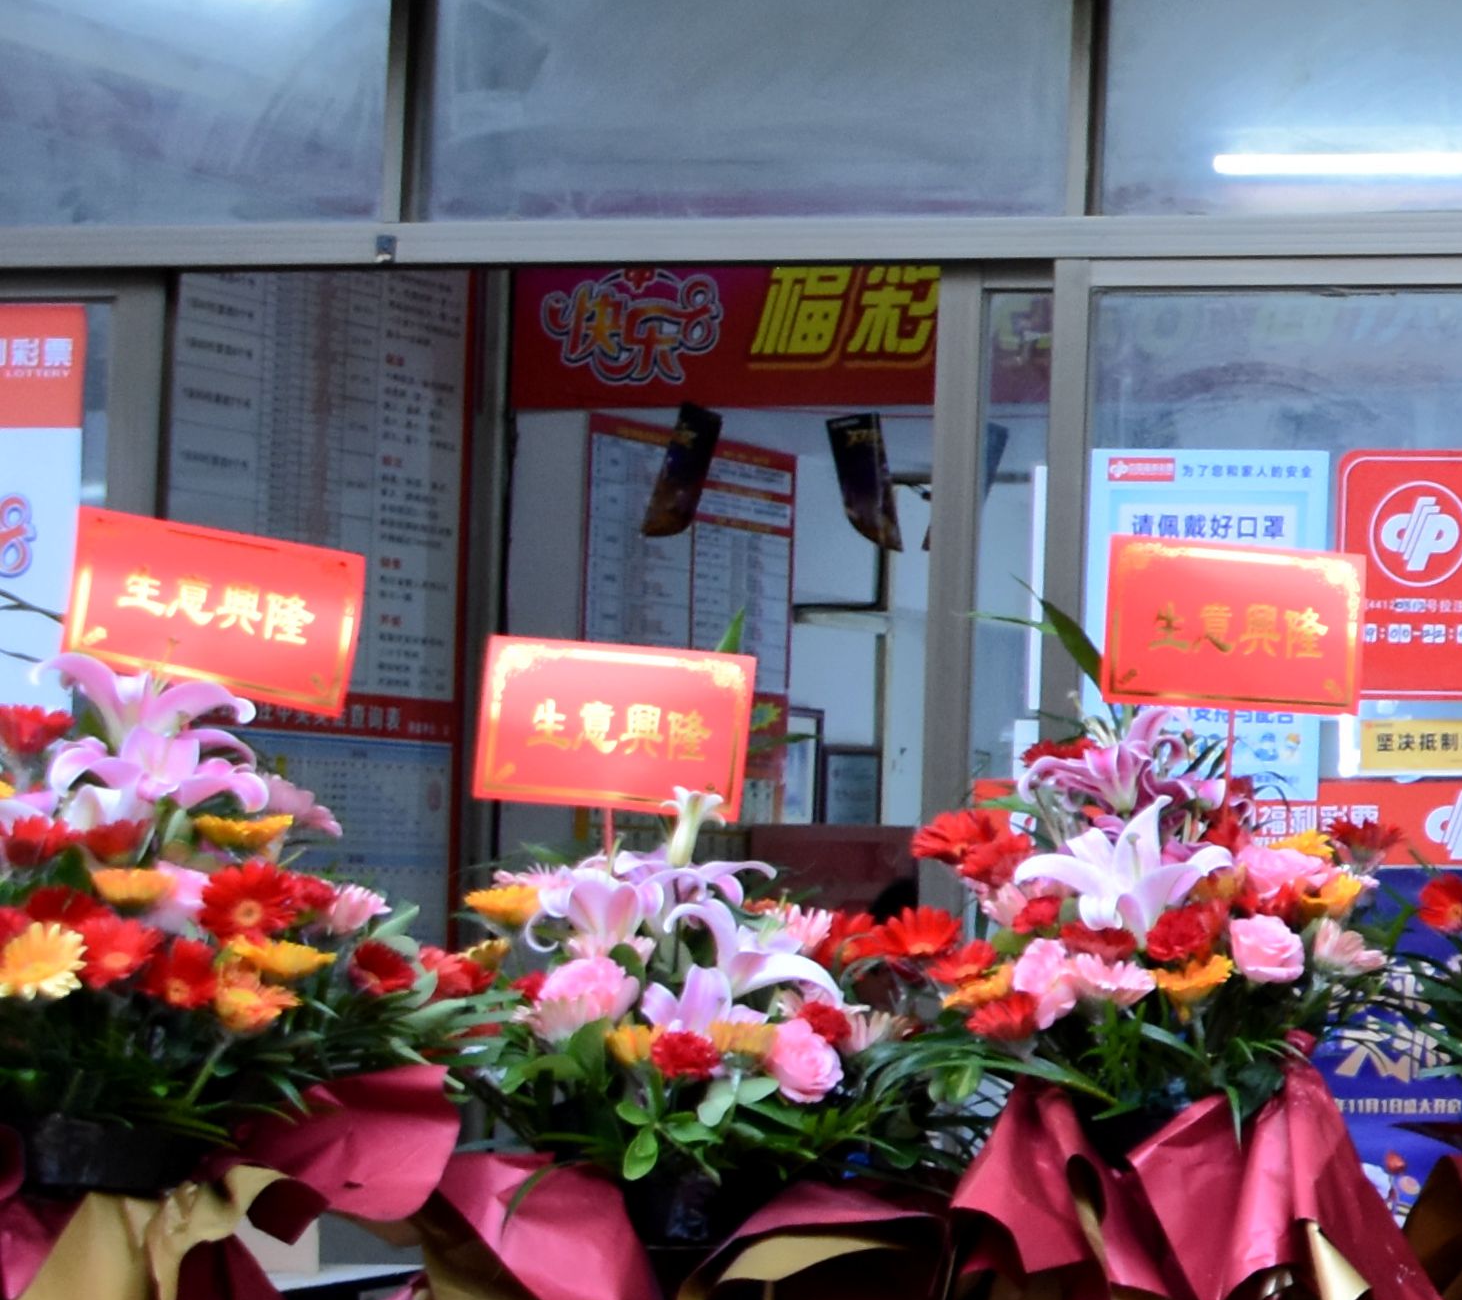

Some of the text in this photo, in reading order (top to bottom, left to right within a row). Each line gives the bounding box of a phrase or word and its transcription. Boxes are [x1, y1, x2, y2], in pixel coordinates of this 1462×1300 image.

[0, 338, 73, 367] 彩票
[1132, 513, 1285, 539] 请佩戴好口罩
